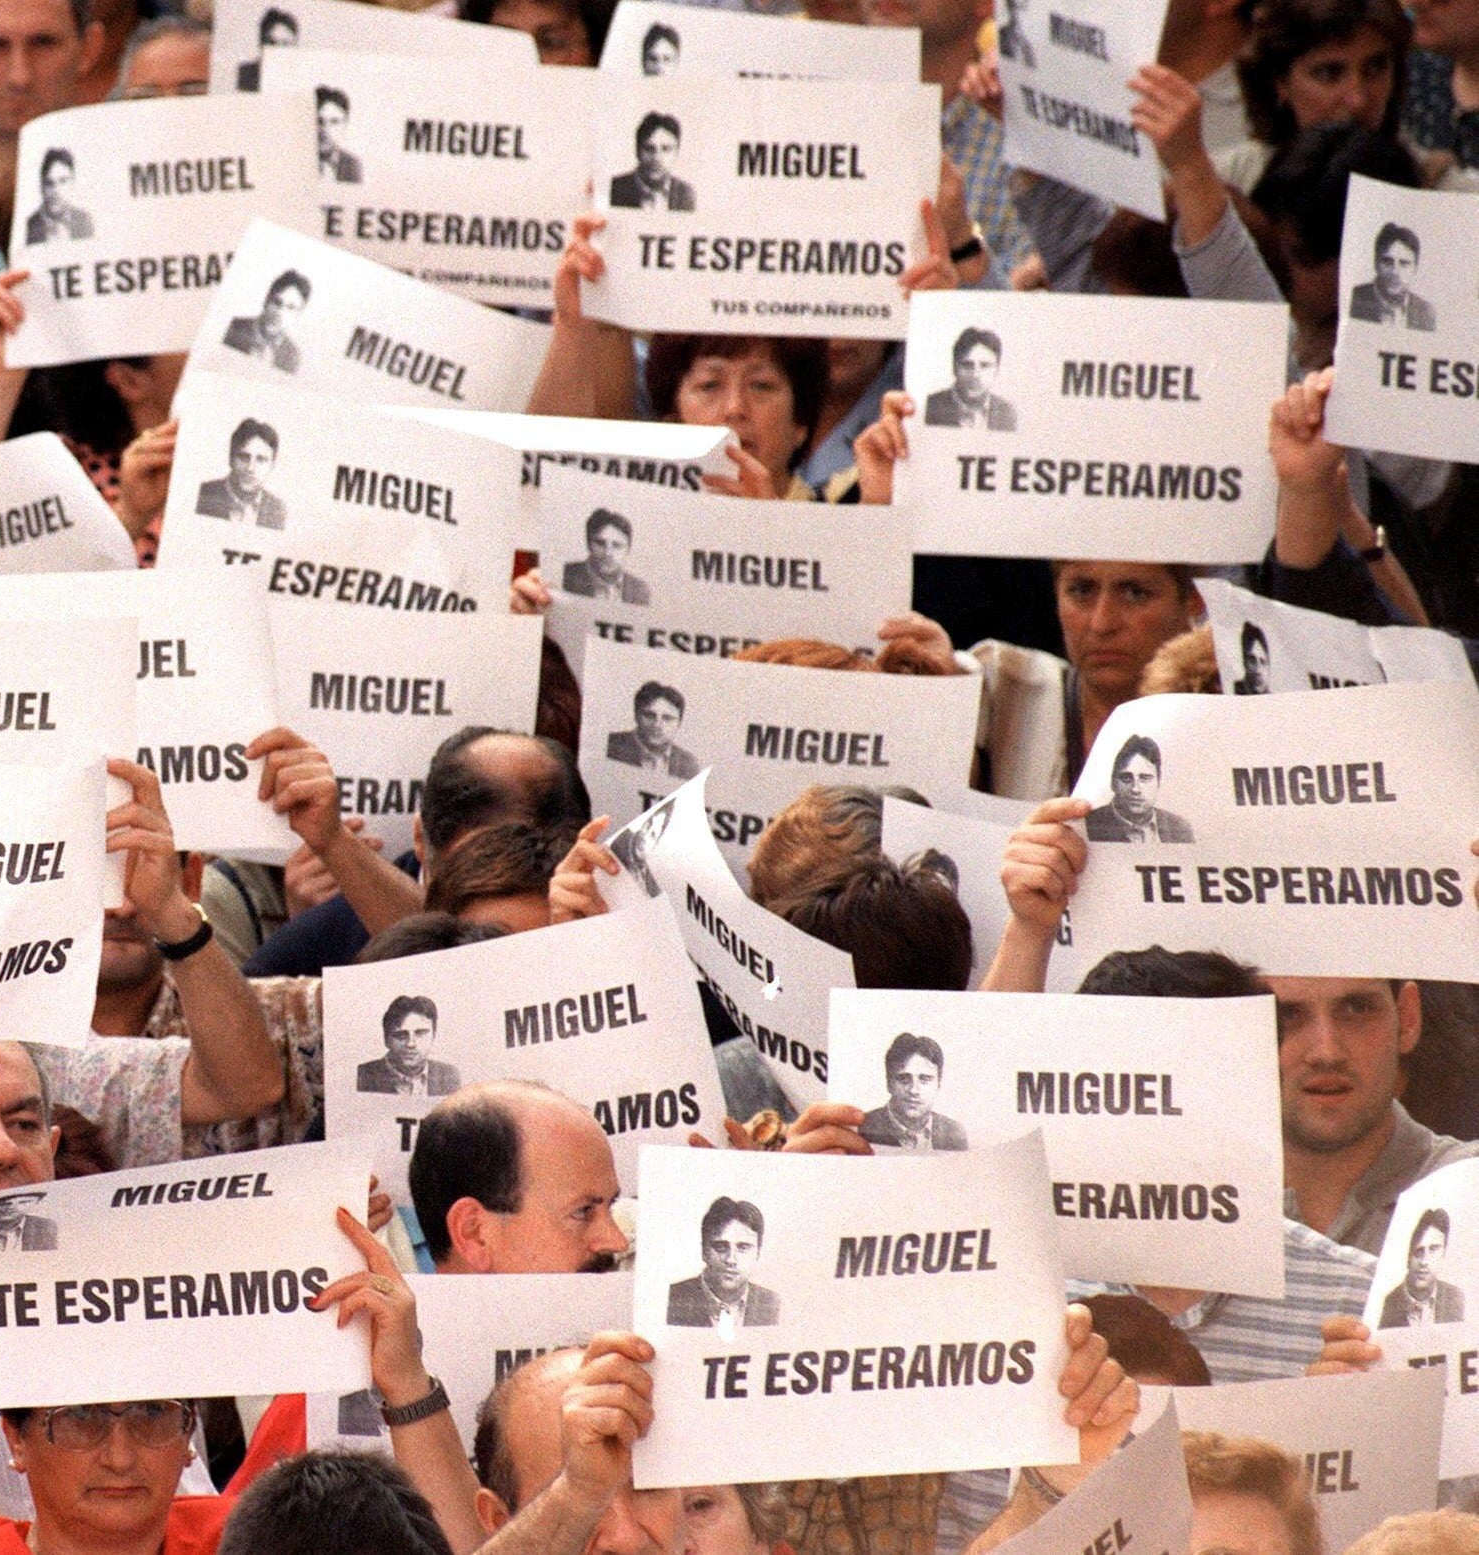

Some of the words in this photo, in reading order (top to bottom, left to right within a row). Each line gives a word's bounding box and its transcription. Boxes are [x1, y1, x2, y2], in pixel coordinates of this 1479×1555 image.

[1049, 13, 1110, 62] MIGUEL
[403, 119, 529, 160] MIGUEL
[737, 142, 867, 180] MIGUEL
[129, 156, 255, 198] MIGUEL
[357, 208, 566, 251] ESPERAMOS
[50, 265, 82, 300] TE
[94, 252, 232, 295] ESPERA
[639, 235, 676, 269] TE
[689, 237, 905, 276] ESPERAMOS
[711, 300, 749, 315] TUS
[755, 302, 891, 319] COMPAÑEROS
[345, 325, 468, 402] MIGUEL
[1062, 360, 1201, 401] MIGUEL
[1378, 351, 1416, 390] TE
[332, 464, 458, 526] MIGUEL
[957, 455, 996, 491] TE
[1011, 457, 1242, 502] ESPERAMOS
[692, 549, 829, 592] MIGUEL
[309, 672, 453, 717] MIGUEL
[745, 723, 890, 766] MIGUEL
[1232, 762, 1397, 806] MIGUEL
[1134, 865, 1185, 903] TE
[1197, 866, 1464, 908] ESPERAMOS
[505, 984, 647, 1048] MIGUEL
[1016, 1071, 1182, 1116] MIGUEL
[111, 1173, 274, 1208] MIGUEL
[1052, 1182, 1240, 1224] ERAMOS
[834, 1229, 998, 1279] MIGUEL
[56, 1266, 329, 1326] ESPERAMOS
[703, 1354, 749, 1400] TE
[764, 1339, 1036, 1397] ESPERAMOS
